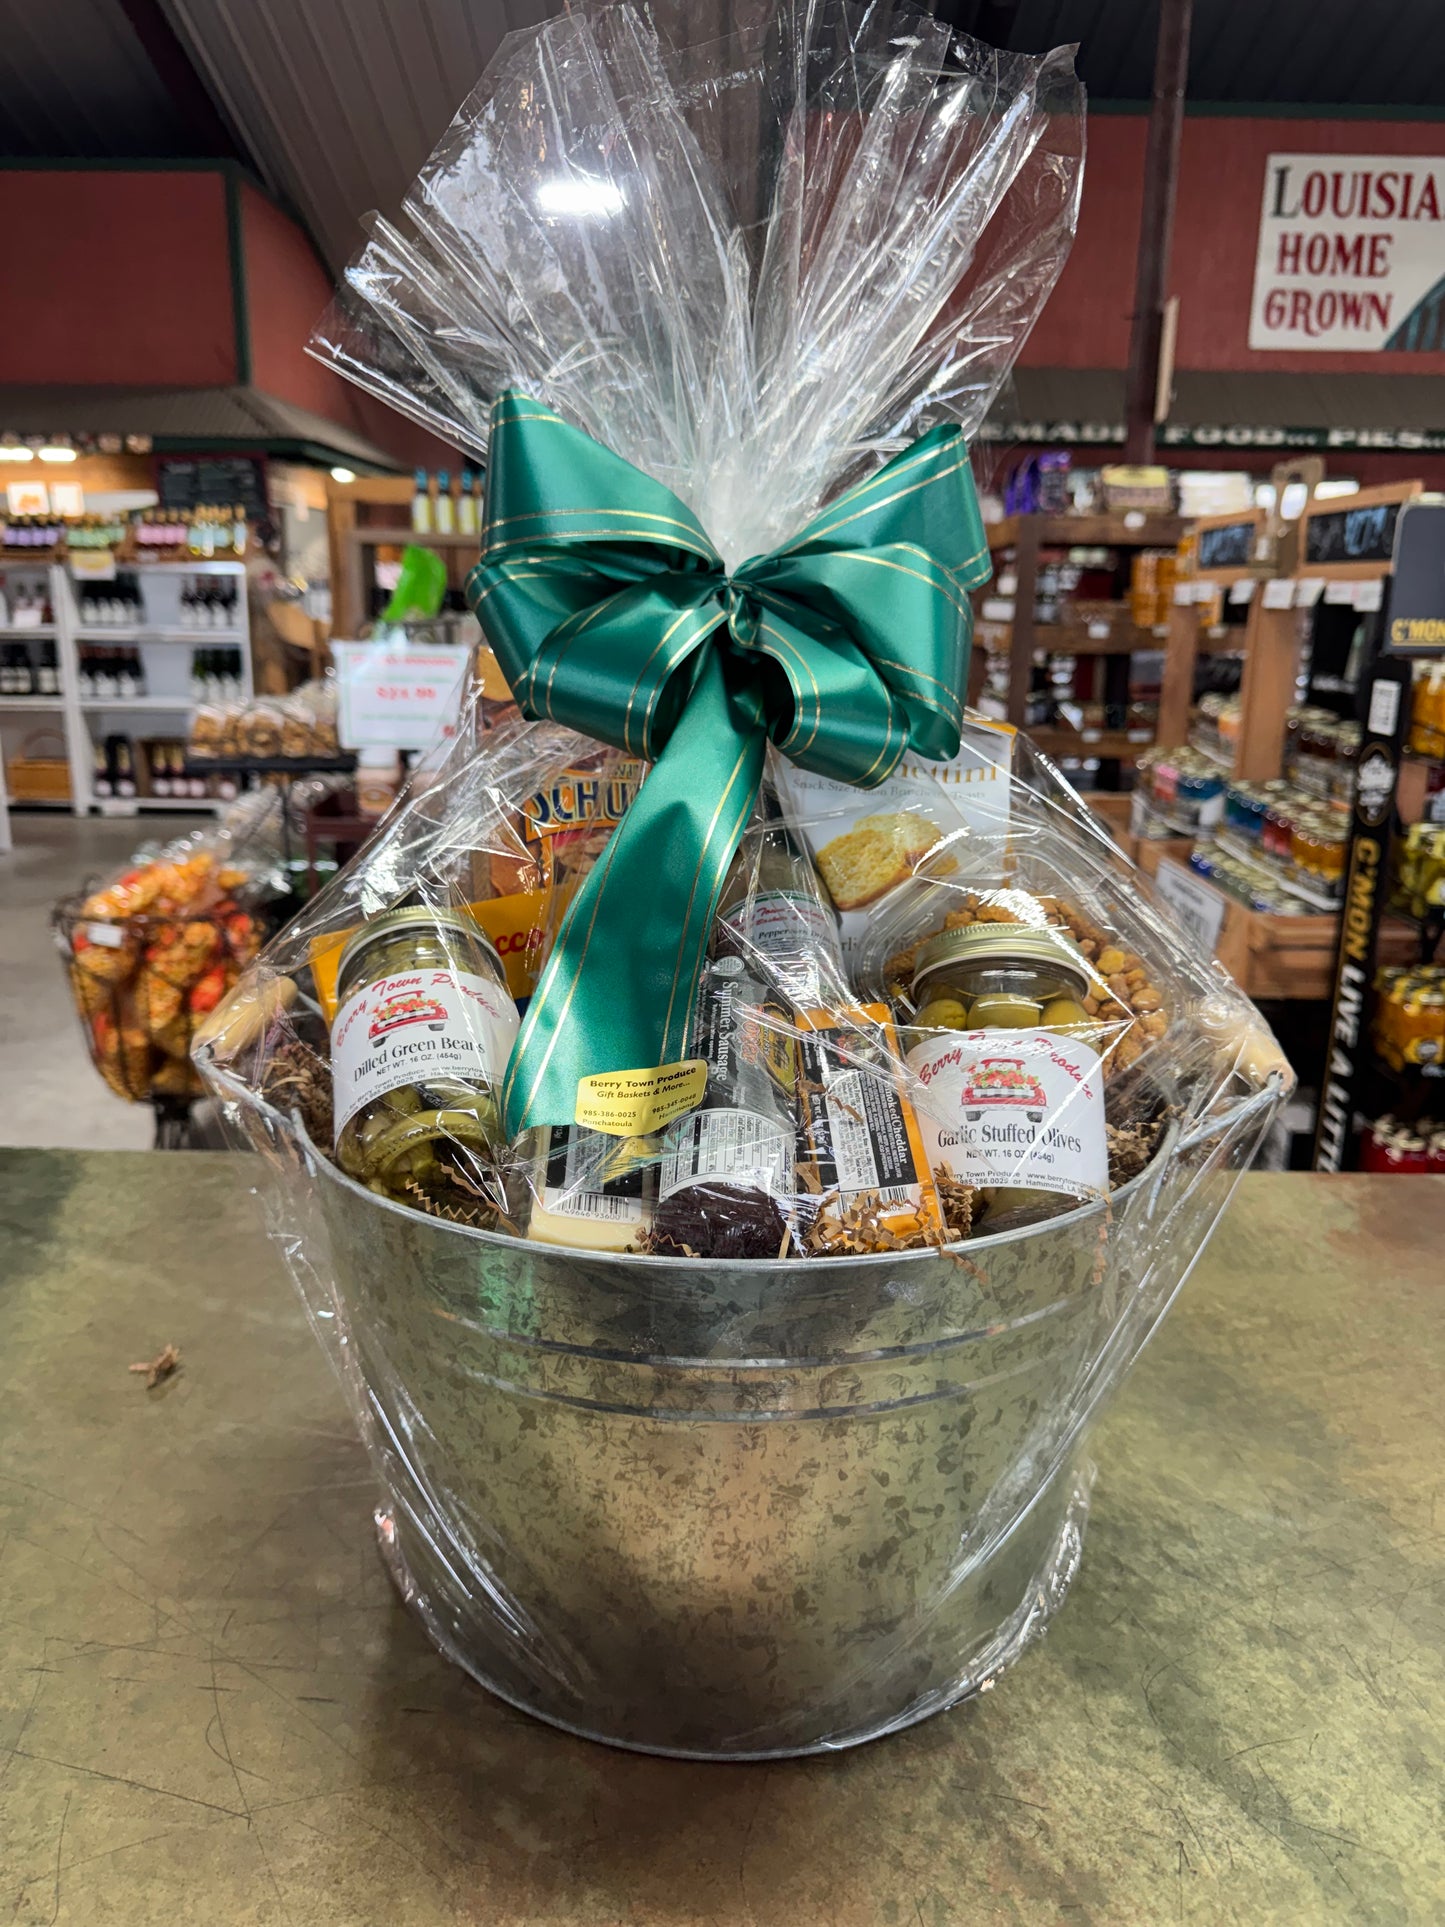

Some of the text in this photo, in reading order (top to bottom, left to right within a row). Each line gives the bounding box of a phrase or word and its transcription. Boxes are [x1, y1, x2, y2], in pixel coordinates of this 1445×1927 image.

[1270, 162, 1445, 222] LOUISIA
[1275, 231, 1394, 278] HOME
[1262, 287, 1393, 337] GROWN
[529, 773, 636, 827] SCHU
[792, 778, 825, 791] Snack
[828, 781, 849, 792] Size
[336, 999, 368, 1047] Berry
[371, 977, 422, 997] Town
[1333, 963, 1366, 1048] LIVE
[354, 1050, 387, 1082] Dilled
[391, 1038, 436, 1058] Green
[376, 1065, 391, 1076] NET
[421, 1053, 435, 1061] OZ.
[436, 1053, 462, 1061] (454g)
[710, 1032, 737, 1081] Sausage
[919, 1047, 963, 1085] Berry
[1329, 1048, 1354, 1077] A
[590, 1067, 697, 1089] Berry Town Produce
[597, 1090, 614, 1099] Gift
[617, 1090, 651, 1099] Baskets
[652, 1087, 660, 1096] &
[582, 1118, 633, 1127] Ponchatoula
[583, 1109, 637, 1118] 985-386-0025
[1315, 1081, 1351, 1172] LITTL
[938, 1123, 1081, 1153] Garlic Stuffed Olives
[985, 1149, 1000, 1157] WT.
[1003, 1149, 1012, 1158] 16
